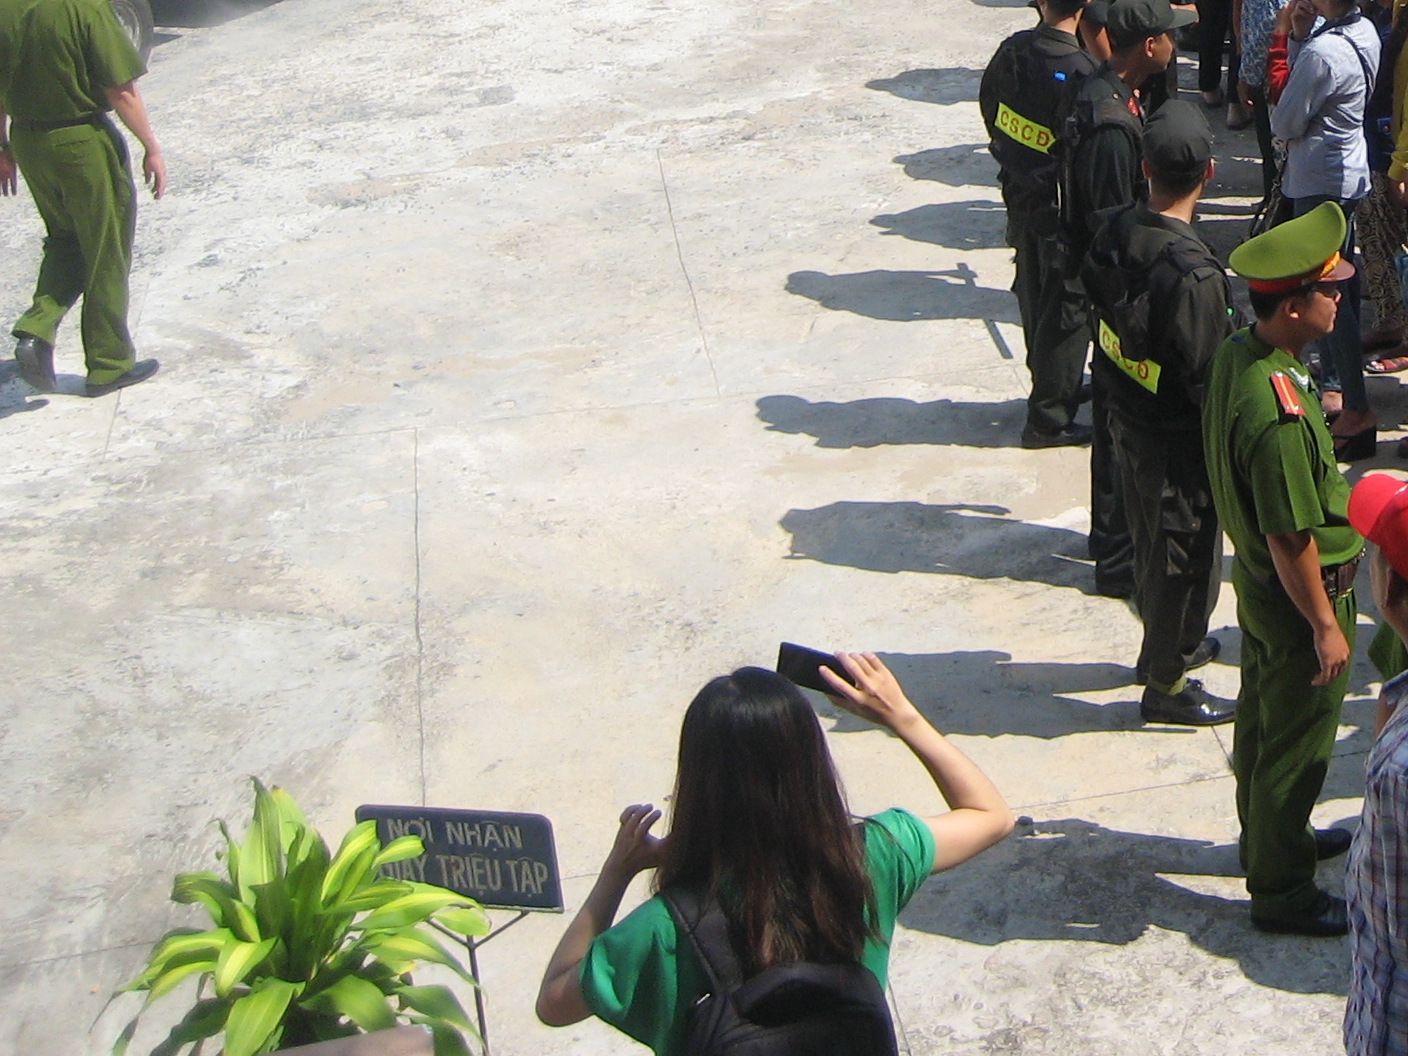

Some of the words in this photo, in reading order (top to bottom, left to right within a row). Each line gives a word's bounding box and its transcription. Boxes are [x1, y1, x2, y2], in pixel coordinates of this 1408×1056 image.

[445, 820, 523, 852] NHẬN
[435, 852, 503, 896] TRIỆU
[505, 856, 549, 898] TẬP
